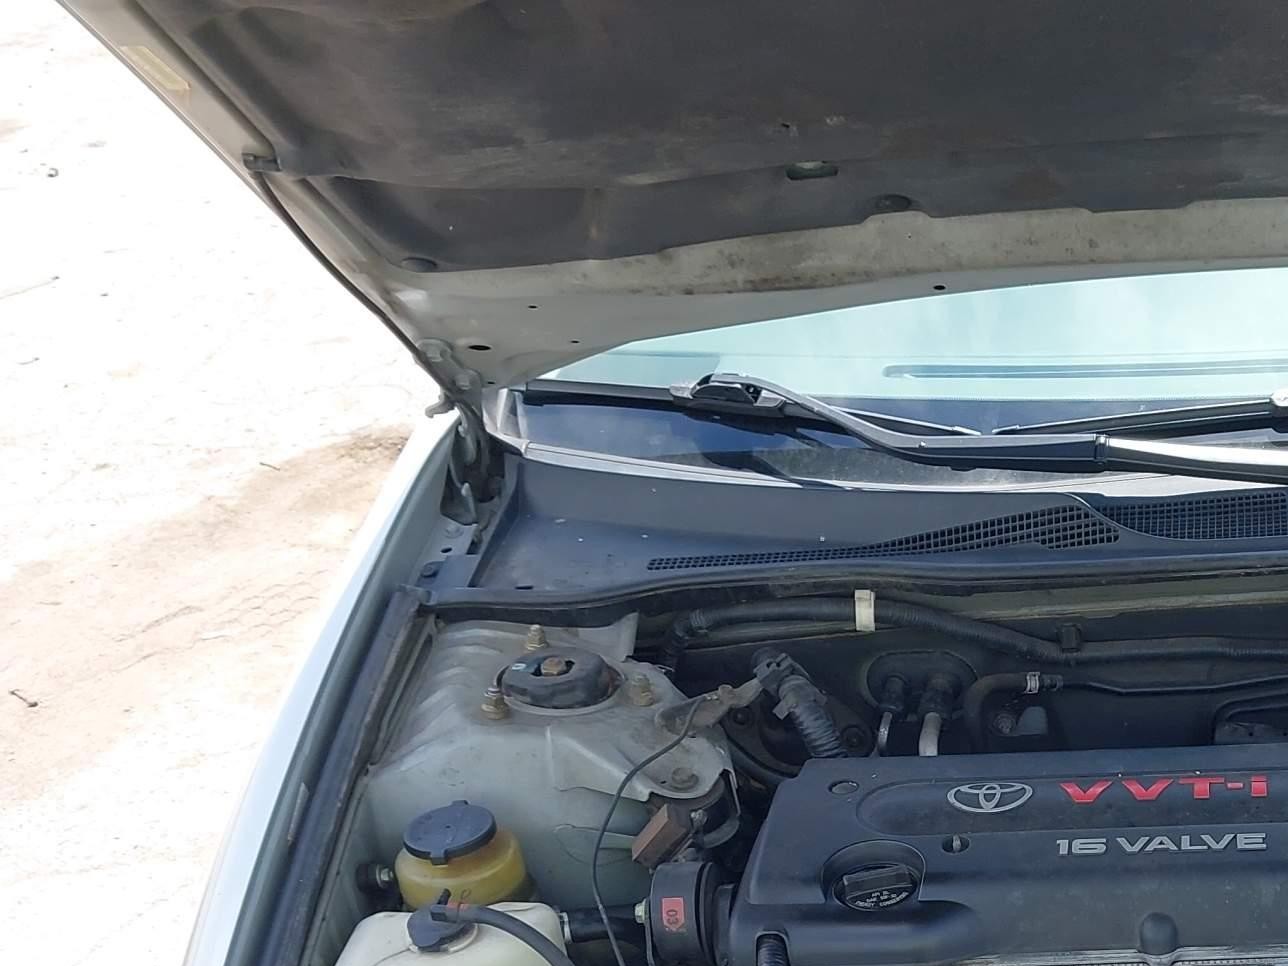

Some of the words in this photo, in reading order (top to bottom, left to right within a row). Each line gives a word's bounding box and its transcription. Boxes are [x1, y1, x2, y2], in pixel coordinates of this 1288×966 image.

[1059, 775, 1268, 803] VVT-i
[1056, 838, 1107, 855] 16
[1116, 832, 1267, 852] VALVE
